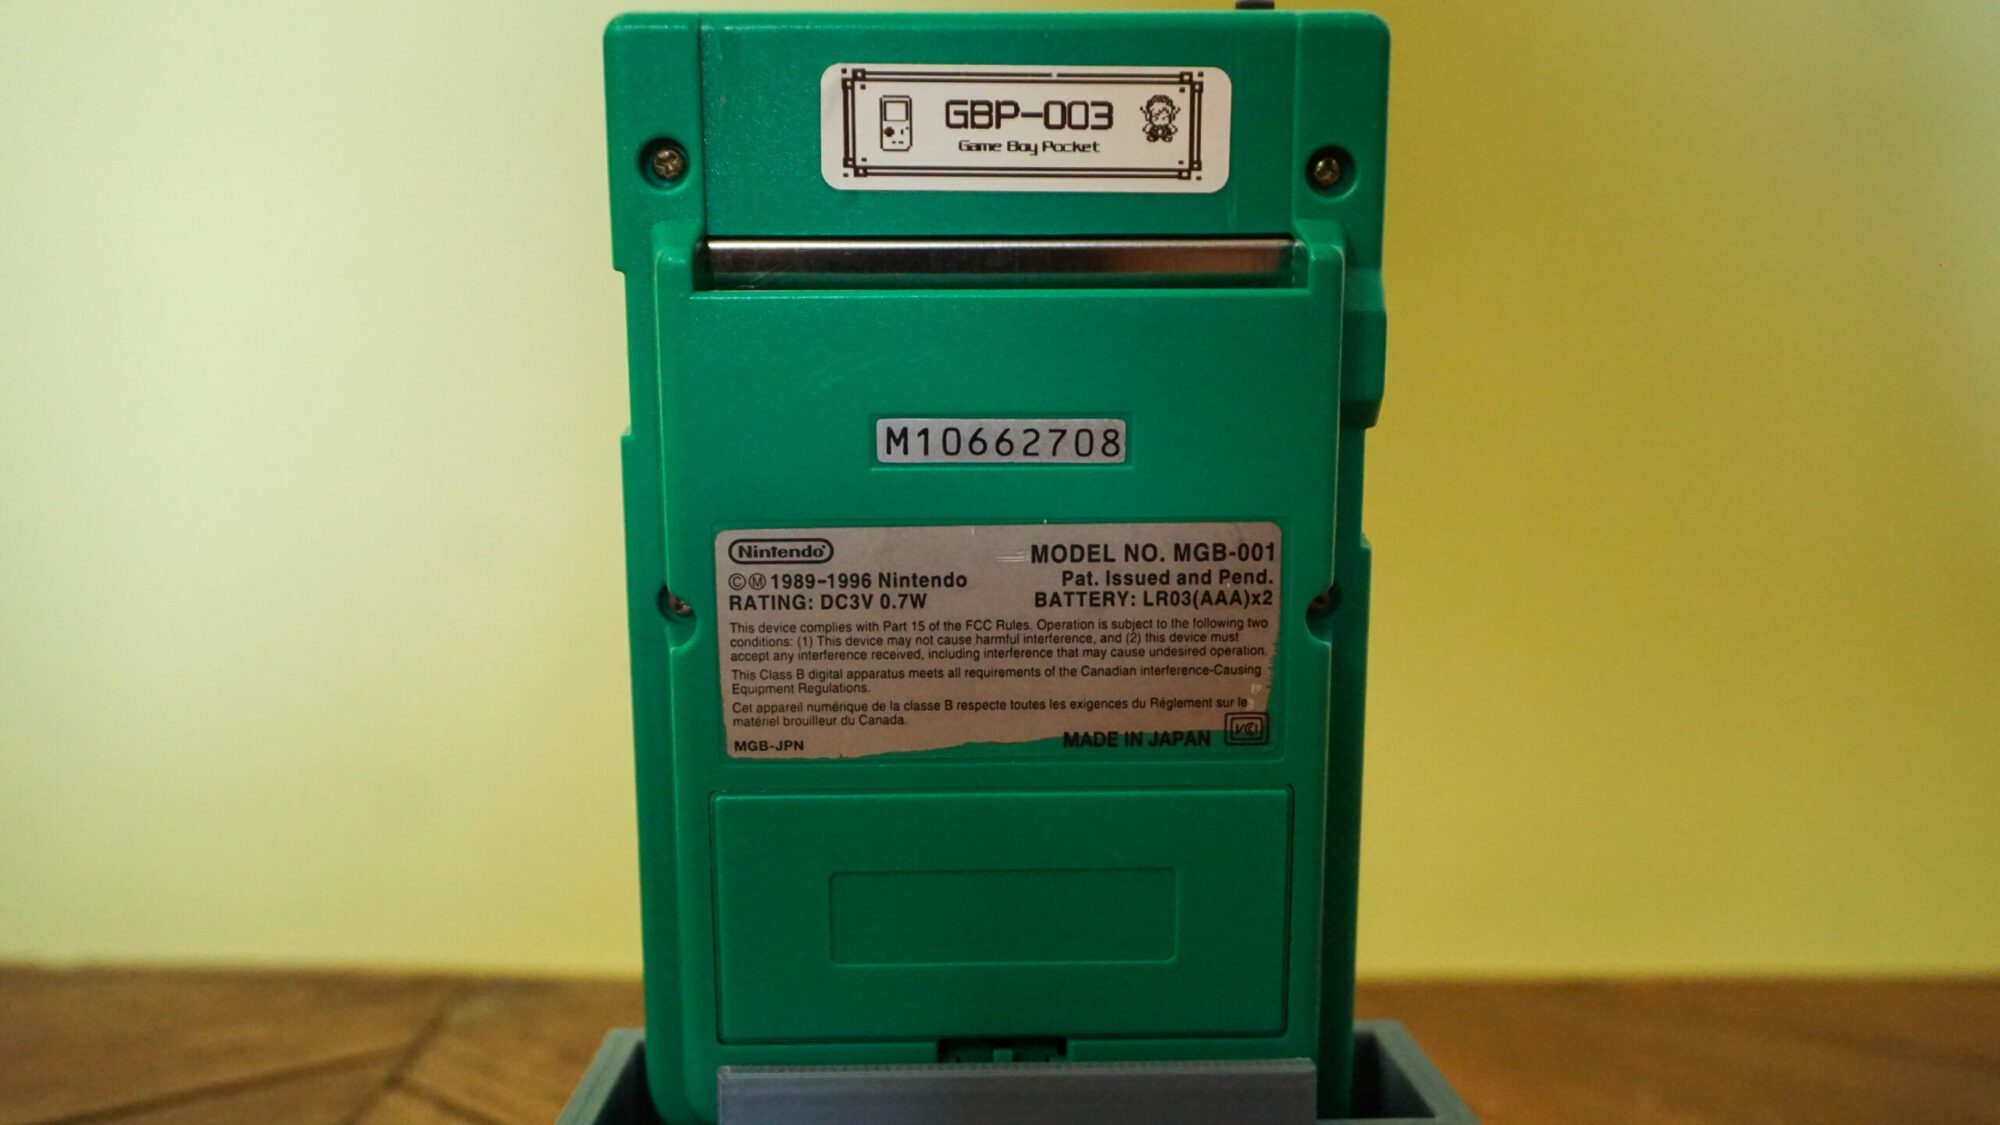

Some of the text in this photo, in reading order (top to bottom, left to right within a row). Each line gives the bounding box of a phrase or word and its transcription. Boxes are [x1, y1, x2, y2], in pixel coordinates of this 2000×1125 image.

[944, 100, 1114, 130] GBP-003
[958, 140, 1100, 155] Game Boy Pocket
[886, 426, 1121, 456] M10662708
[1031, 542, 1275, 563] MODEL NO. MGB-001
[771, 573, 871, 589] 1989-1996
[878, 572, 968, 588] Nintendo
[1062, 569, 1273, 586] Pat. Issued and Pend.
[729, 593, 927, 610] RATING: DC3V 0.7W
[1035, 590, 1273, 609] BATTERY: LR03(AAA)x2
[729, 618, 1268, 635] This device complies with Part 15 of the FCC Rules. Operation is subject to the following two
[730, 632, 1239, 648] conditions: (1) This device may not cause harmful interference, and (2) this device must
[731, 646, 1267, 663] accept any interference received, including interference that may cause undesired operation.
[731, 669, 756, 680] This
[760, 669, 792, 680] Class
[796, 669, 805, 680] B
[808, 669, 843, 682] digital
[847, 669, 905, 681] apparatus
[909, 669, 944, 678] meets
[948, 668, 961, 678] all
[965, 667, 1040, 680] requirements
[1045, 666, 1056, 676] of
[1059, 666, 1077, 676] the
[1081, 666, 1137, 676] Canadian
[732, 683, 870, 696] Equipment Regulations.
[732, 703, 753, 713] Cet
[756, 702, 803, 715] appareil
[807, 701, 868, 714] numérique
[872, 701, 886, 711] de
[890, 701, 900, 711] la
[903, 701, 941, 711] classe
[945, 700, 953, 710] B
[957, 700, 1006, 712] respecte
[1011, 699, 1046, 710] toutes
[1049, 699, 1065, 709] les
[1071, 698, 1128, 711] exigences
[1132, 698, 1146, 708] du
[1216, 698, 1234, 707] sur
[1238, 697, 1248, 707] le
[733, 714, 907, 727] matériel brouilleur du Canada.
[734, 741, 804, 752] MGB-JPN
[1064, 731, 1210, 747] MADE IN JAPAN
